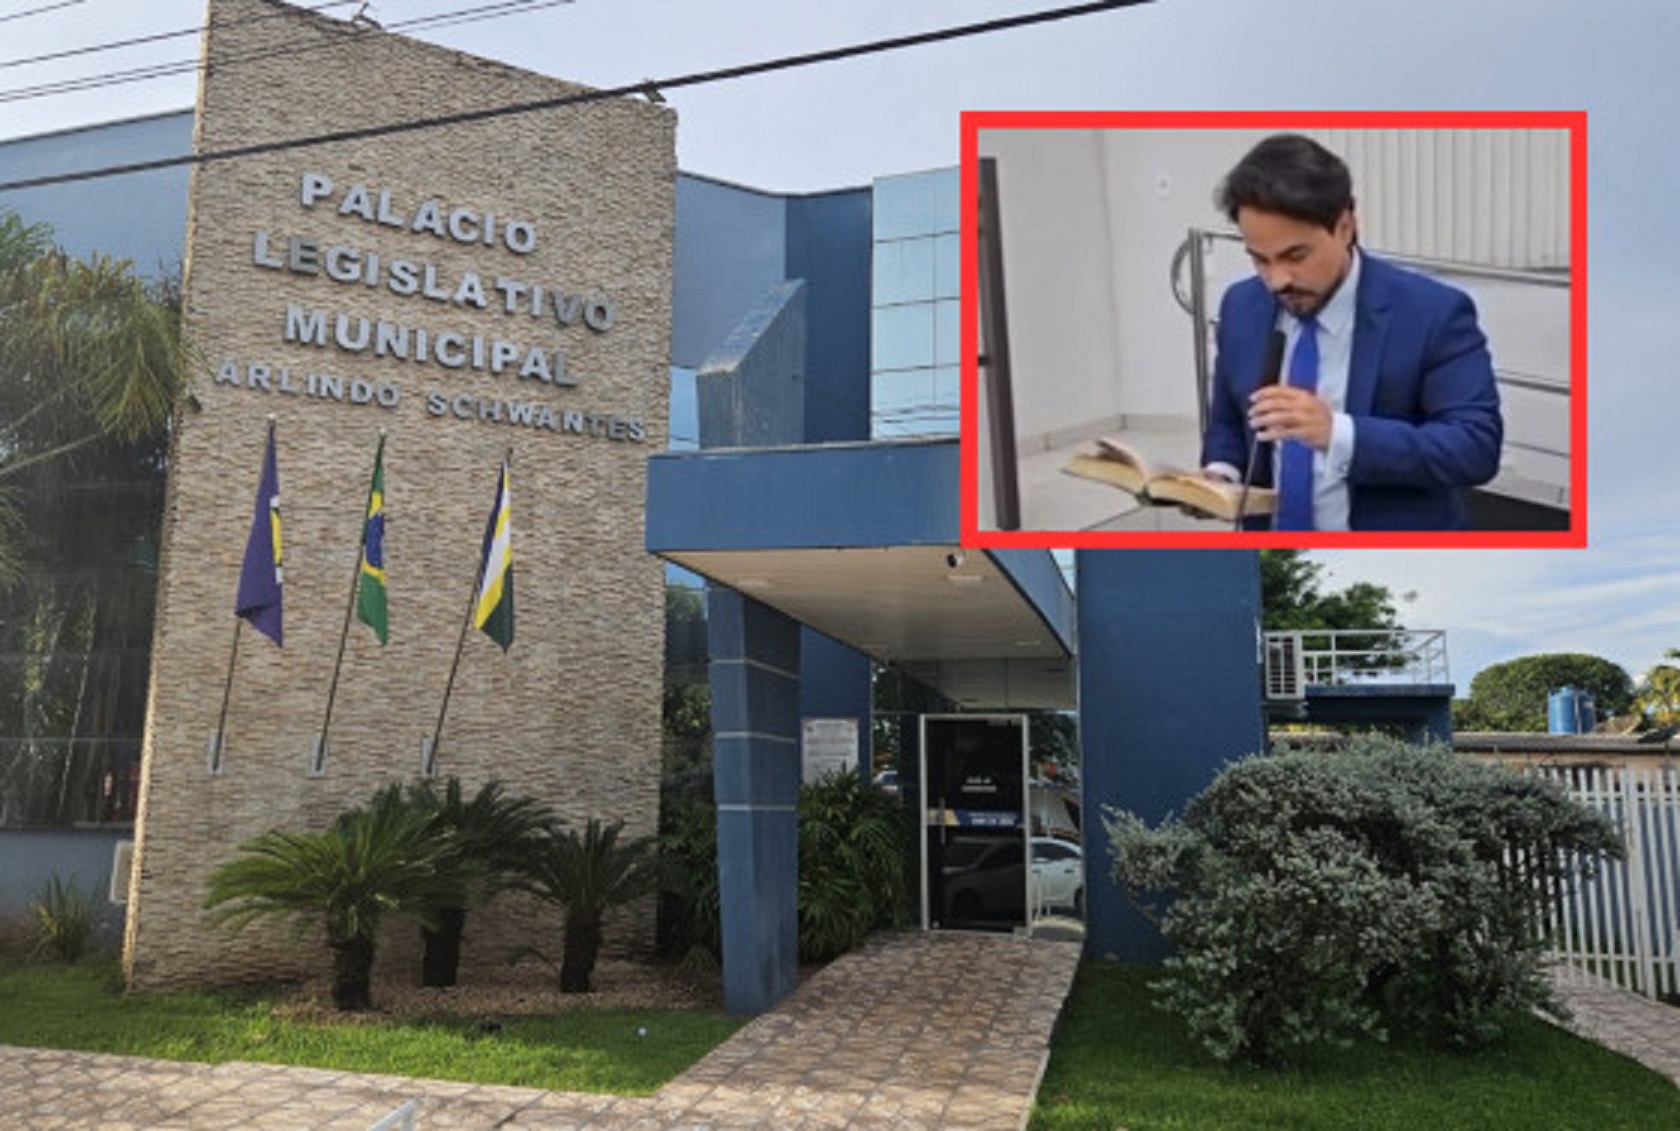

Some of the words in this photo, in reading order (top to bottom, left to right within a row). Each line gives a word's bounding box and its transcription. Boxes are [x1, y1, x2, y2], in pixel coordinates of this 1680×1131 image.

[252, 229, 617, 331] LEGISLATIVO
[284, 303, 578, 386] MUNICIPAL
[215, 359, 400, 407] ARLINDO
[427, 391, 646, 441] SCHWANTES
